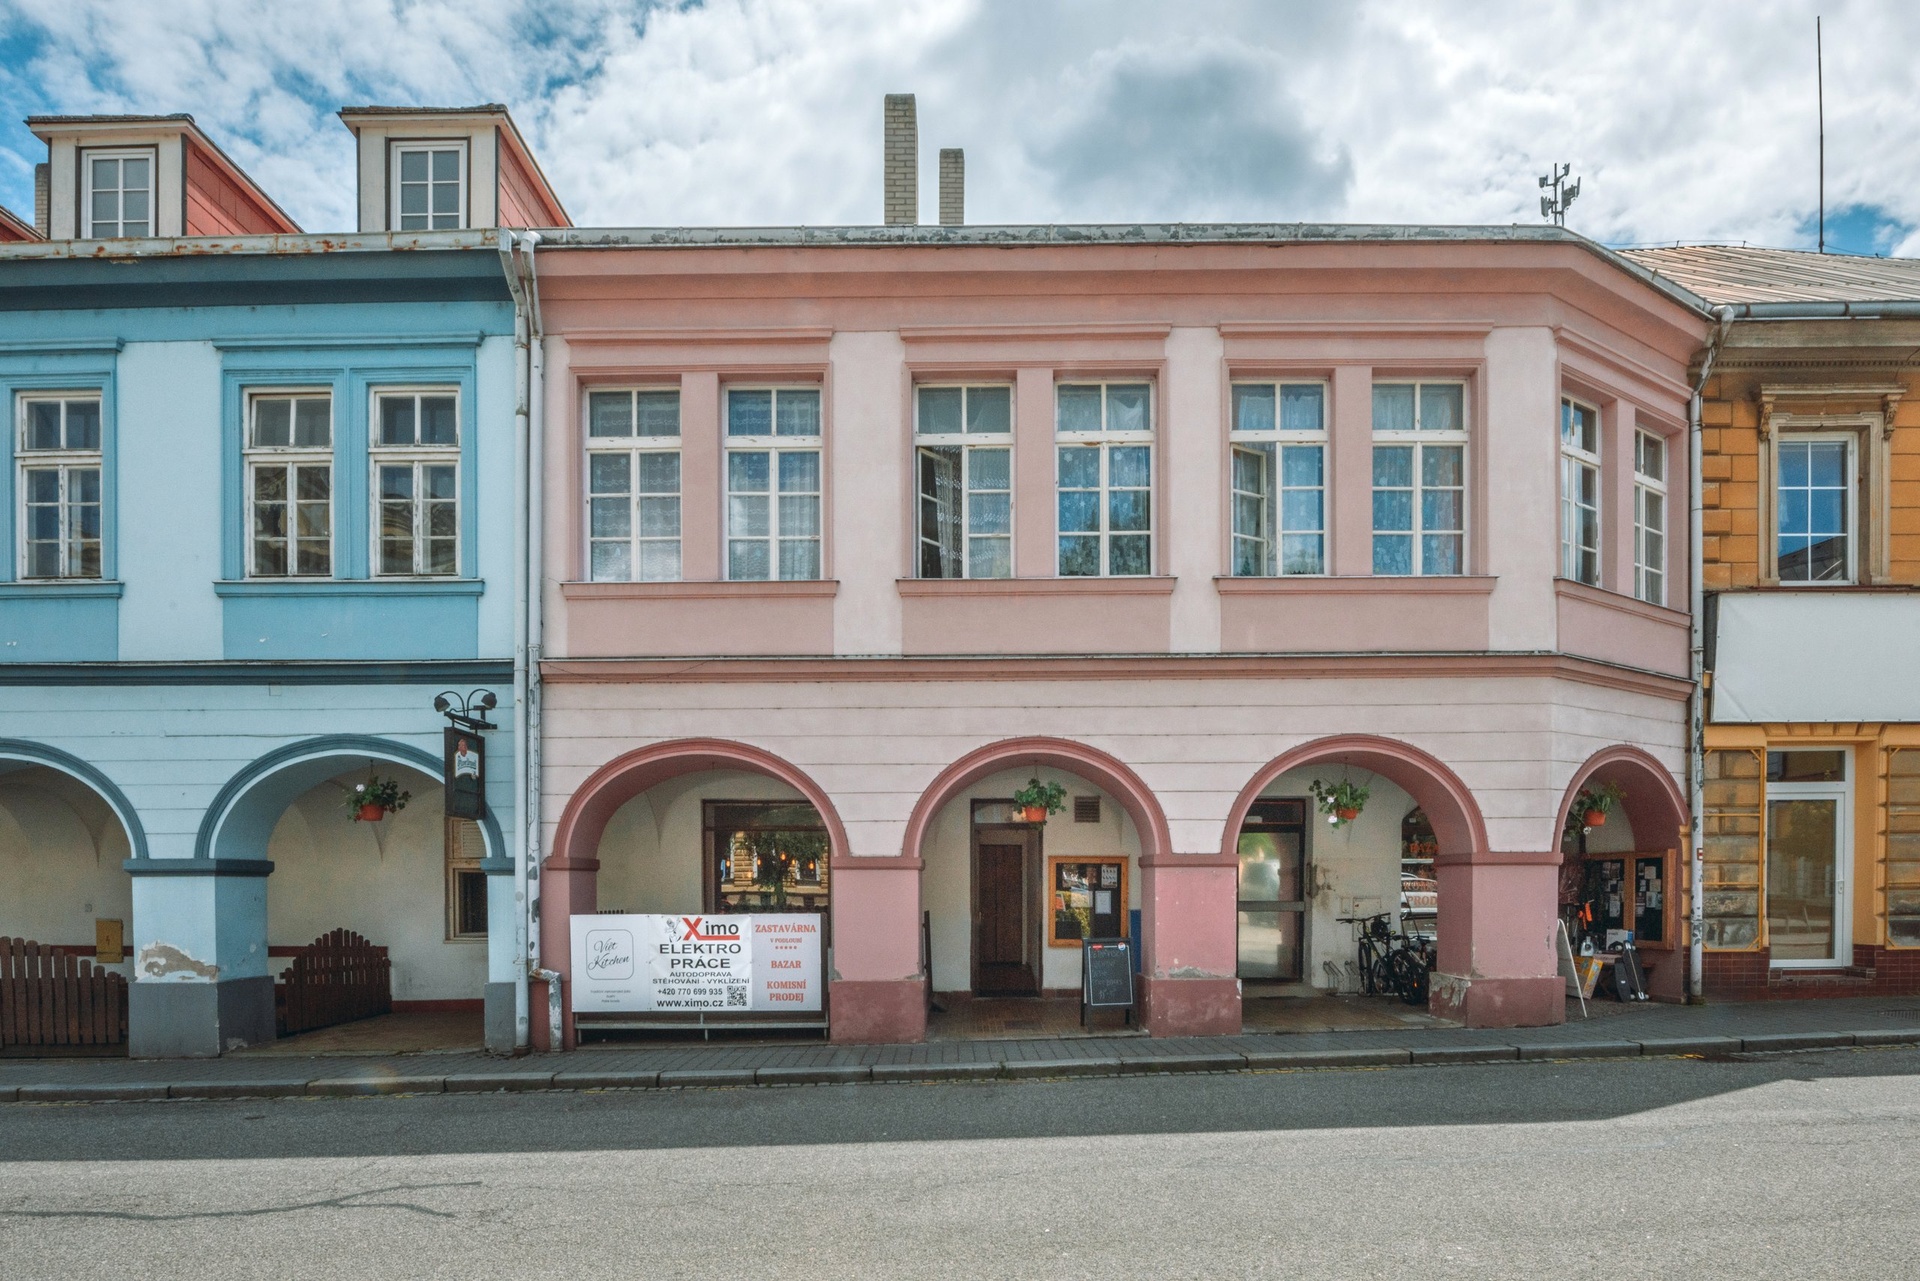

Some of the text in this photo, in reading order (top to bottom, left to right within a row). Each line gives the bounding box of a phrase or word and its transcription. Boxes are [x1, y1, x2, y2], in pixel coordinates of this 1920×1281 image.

[682, 917, 740, 941] Ximo
[755, 923, 816, 933] ZASTAVÁRNA
[659, 943, 742, 954] ELEKTRO
[588, 953, 630, 970] Kitchen
[670, 956, 731, 969] PRÁCE
[771, 960, 801, 969] BAZAR
[766, 979, 807, 990] KOMISNÍ
[656, 998, 724, 1007] www.ximo.cz
[769, 992, 804, 1003] PRODEJ
